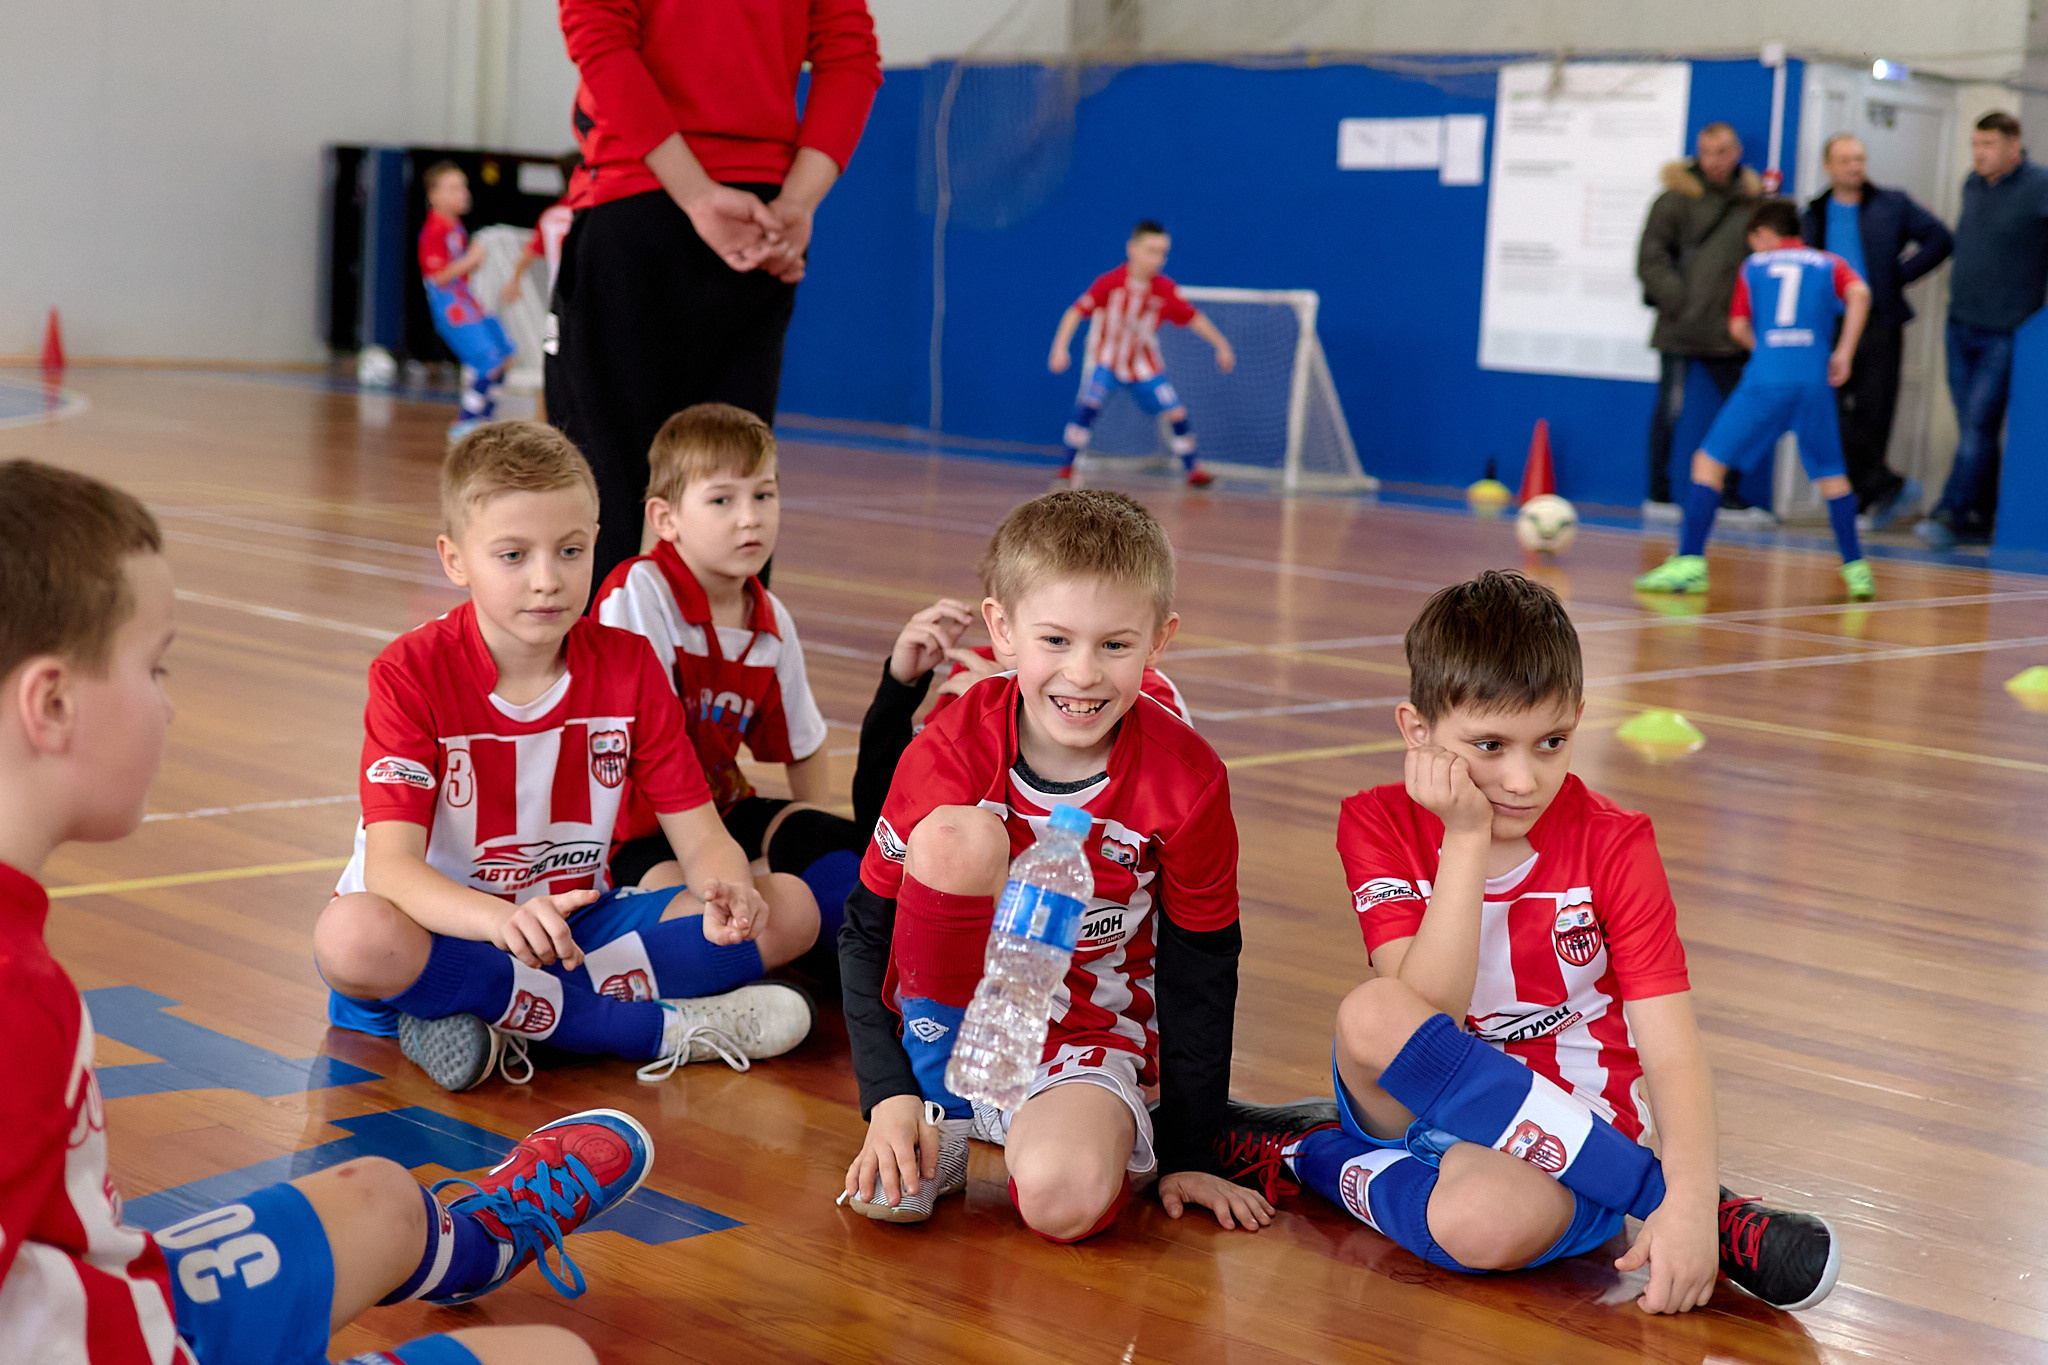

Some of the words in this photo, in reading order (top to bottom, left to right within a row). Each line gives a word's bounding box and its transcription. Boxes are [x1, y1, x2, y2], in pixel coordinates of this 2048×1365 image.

[1767, 264, 1803, 328] 7
[447, 748, 473, 807] 3
[469, 848, 600, 883] АВТОРЕГИОН
[153, 1204, 281, 1304] 30
